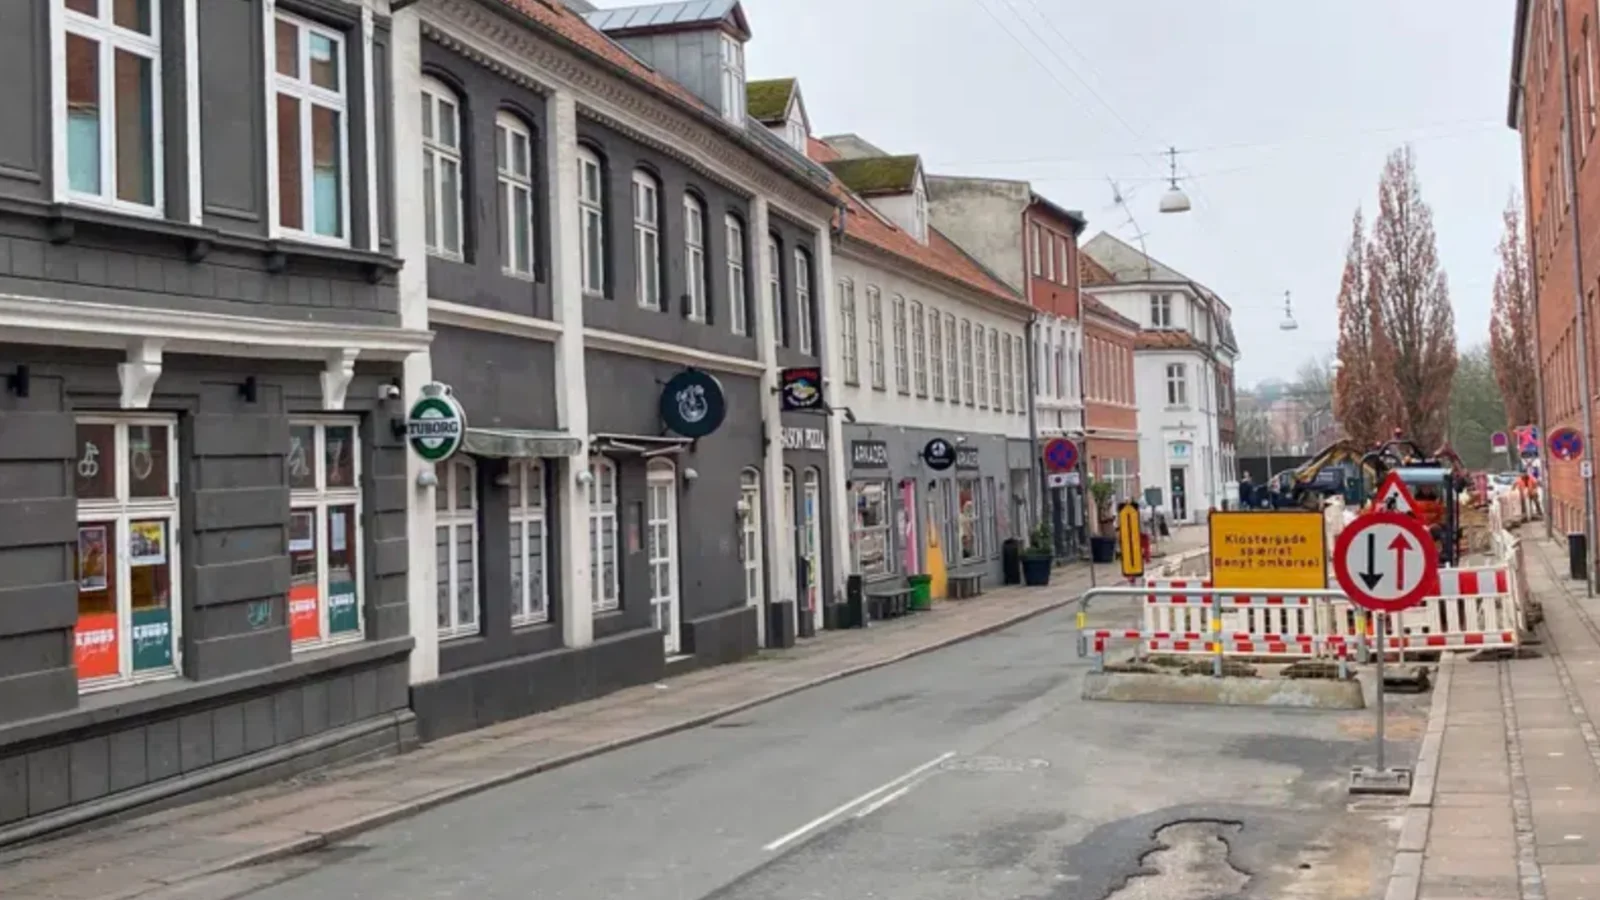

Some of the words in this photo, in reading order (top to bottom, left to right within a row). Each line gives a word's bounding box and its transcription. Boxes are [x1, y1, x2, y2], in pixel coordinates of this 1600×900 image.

[408, 421, 458, 434] TUBORG
[805, 428, 826, 450] PIZZA
[854, 444, 886, 463] ARKADEN
[1225, 535, 1306, 545] Klostergade
[1241, 547, 1292, 557] spærret
[1215, 558, 1252, 568] Benyt
